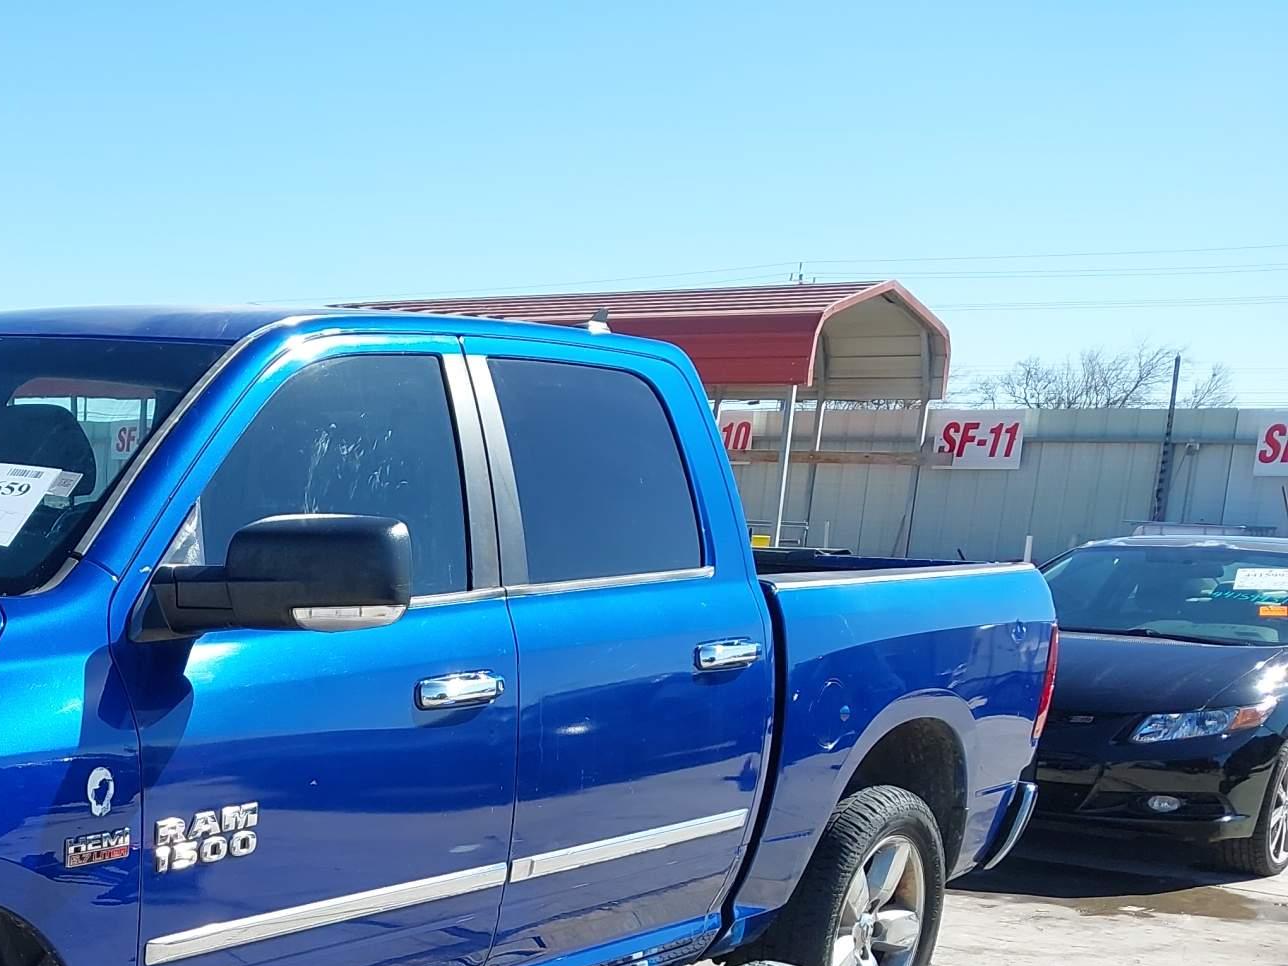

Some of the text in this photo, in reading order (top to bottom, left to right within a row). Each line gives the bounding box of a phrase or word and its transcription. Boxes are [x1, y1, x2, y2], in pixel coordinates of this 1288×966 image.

[938, 421, 1020, 458] SF-11
[66, 827, 131, 854] HEMI
[155, 801, 259, 846] RAM
[93, 846, 128, 861] LITER
[155, 830, 258, 873] 1500
